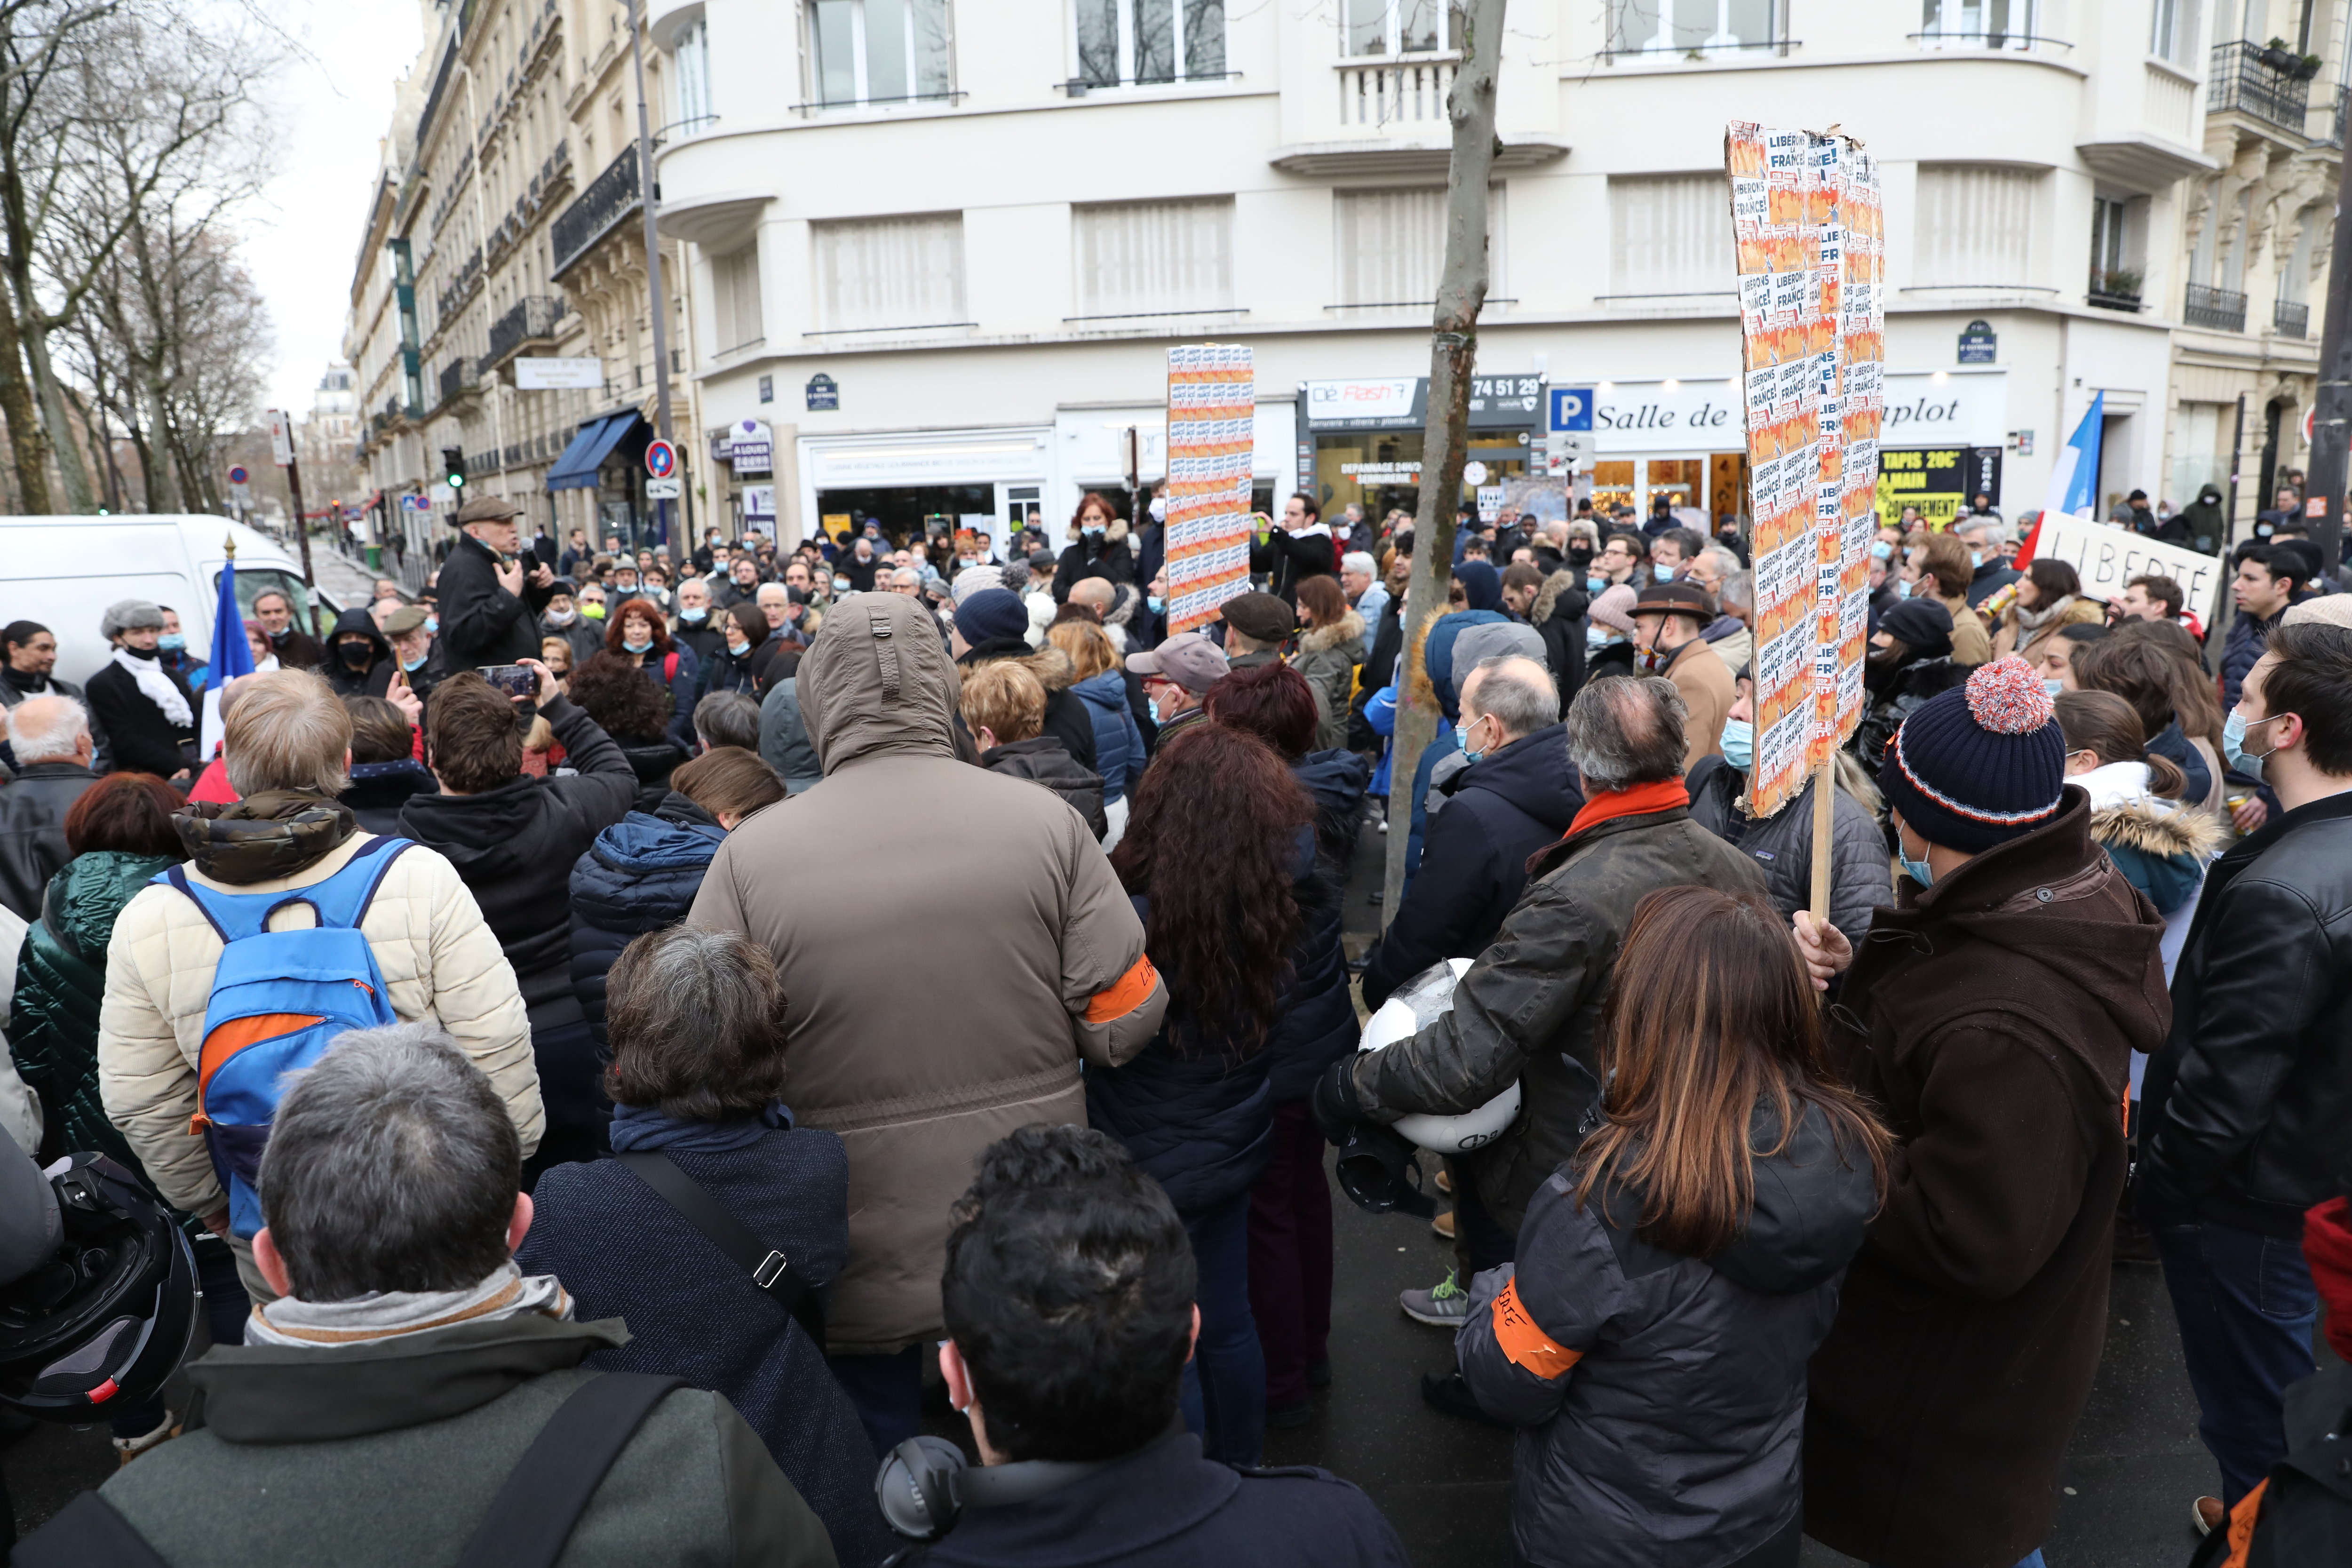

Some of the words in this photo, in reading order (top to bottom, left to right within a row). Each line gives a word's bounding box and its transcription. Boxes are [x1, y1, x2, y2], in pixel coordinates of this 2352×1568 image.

[1770, 133, 1805, 147] LIBÉRONS
[1771, 150, 1804, 167] FRANCE!
[1777, 271, 1805, 288] LIBÉRONS
[1778, 284, 1806, 308] FRANCE!
[1748, 369, 1775, 389] LIBÉRONS
[1780, 360, 1805, 382] LIBÉRONS
[1855, 363, 1875, 377] LIBÉRONS
[1344, 385, 1391, 400] Flash
[1473, 380, 1493, 396] 74
[1496, 379, 1513, 396] 51
[1519, 379, 1539, 395] 29
[1782, 374, 1805, 400] FRANCE!
[1855, 375, 1875, 393] FRANCE!
[1751, 383, 1777, 409] FRANCE!
[1561, 396, 1582, 425] P
[1596, 405, 1675, 430] Salle
[1690, 403, 1727, 426] de
[1853, 440, 1872, 455] LIBÉRONS
[1756, 461, 1780, 483] LIBÉRONS
[1784, 449, 1805, 472] LIBÉRONS
[1853, 452, 1872, 471] FRANCE!
[1883, 452, 1922, 470] TAPIS
[1357, 473, 1411, 485] SERRURERIE
[1785, 462, 1806, 490] FRANCE!
[1890, 471, 1927, 488] MAIN
[1756, 474, 1780, 502] FRANCE!
[1851, 516, 1868, 532] LIBÉRONS
[1785, 534, 1805, 561] LIBÉRONS
[1851, 525, 1868, 548] FRANCE!
[1758, 550, 1781, 575] LIBÉRONS
[1786, 547, 1806, 579] FRANCE!
[1759, 563, 1782, 593] FRANCE!
[1848, 590, 1864, 608] LIBÉRONS
[1848, 598, 1864, 623] FRANCE!
[1786, 619, 1806, 646] LIBÉRONS
[1761, 637, 1782, 664] LIBÉRONS
[1786, 631, 1806, 664] FRANCE!
[1761, 650, 1783, 682] FRANCE!
[1846, 660, 1861, 681] LIBÉRONS
[1785, 703, 1804, 730] LIBÉRONS
[1762, 722, 1781, 750] LIBÉRONS
[1785, 715, 1804, 748] FRANCE!
[1761, 734, 1782, 768] FRANCE!
